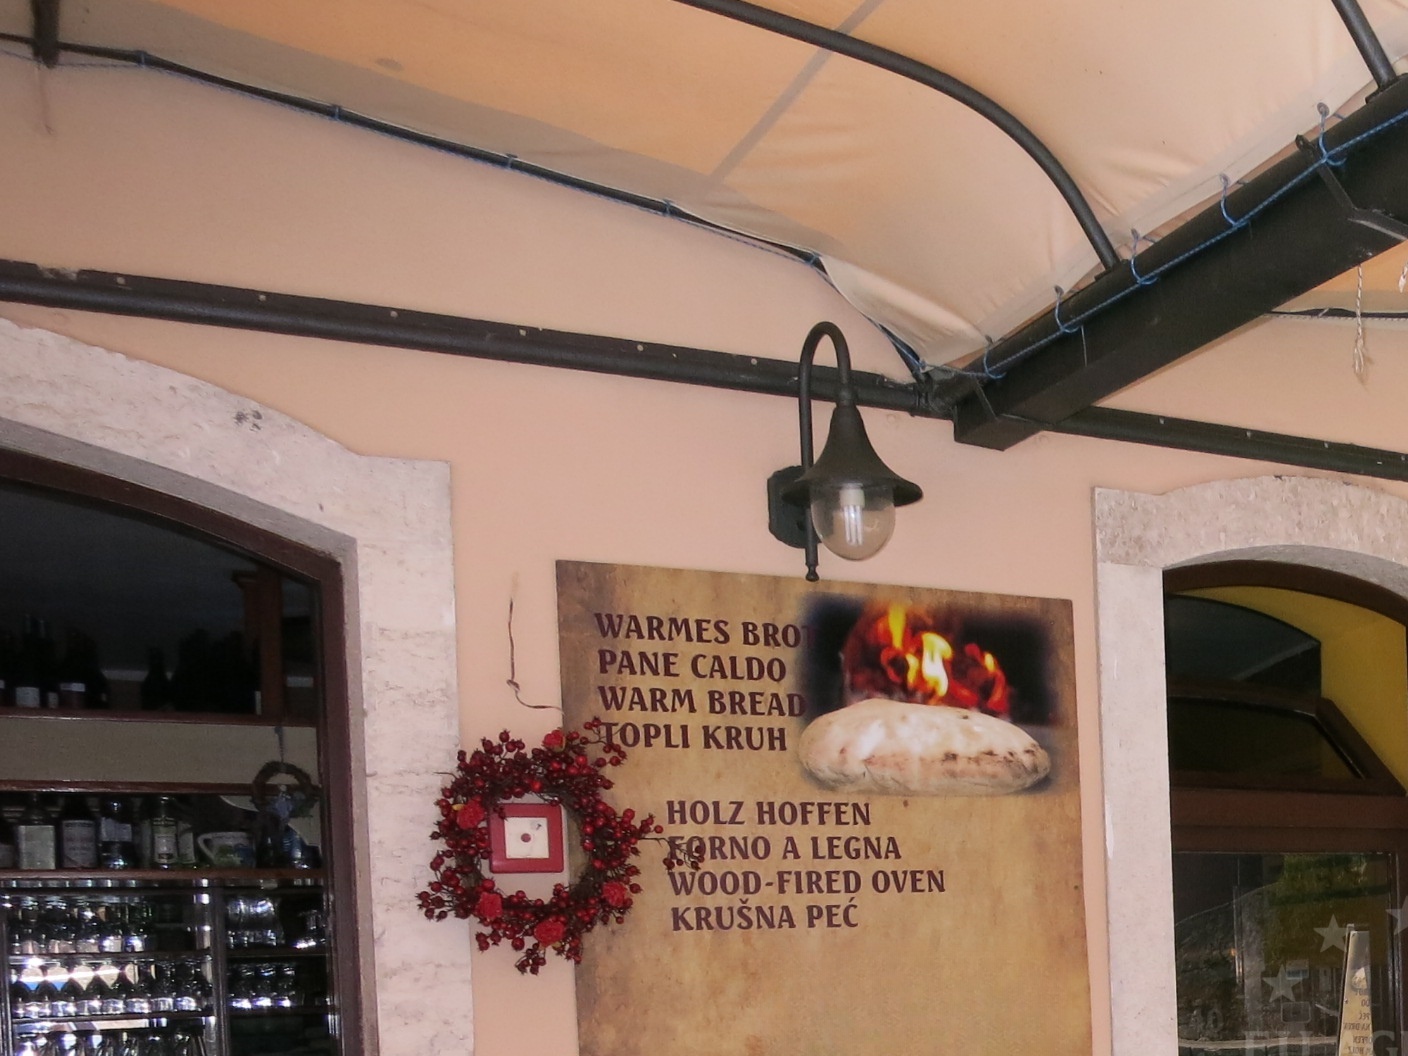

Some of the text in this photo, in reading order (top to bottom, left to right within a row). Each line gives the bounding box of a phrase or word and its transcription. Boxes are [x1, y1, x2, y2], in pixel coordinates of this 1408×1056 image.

[594, 612, 731, 644] WARMES
[597, 648, 787, 683] PANE CALDO
[598, 685, 808, 717] WARM BREAD
[601, 721, 787, 751] TOPLI KRUH
[667, 800, 871, 827] HOLZ HOFFEN
[668, 836, 902, 861] FORNO A LEGNA
[668, 869, 946, 896] WOOD-FIRED OVEN
[671, 896, 859, 932] KRUŠNA PEĆ
